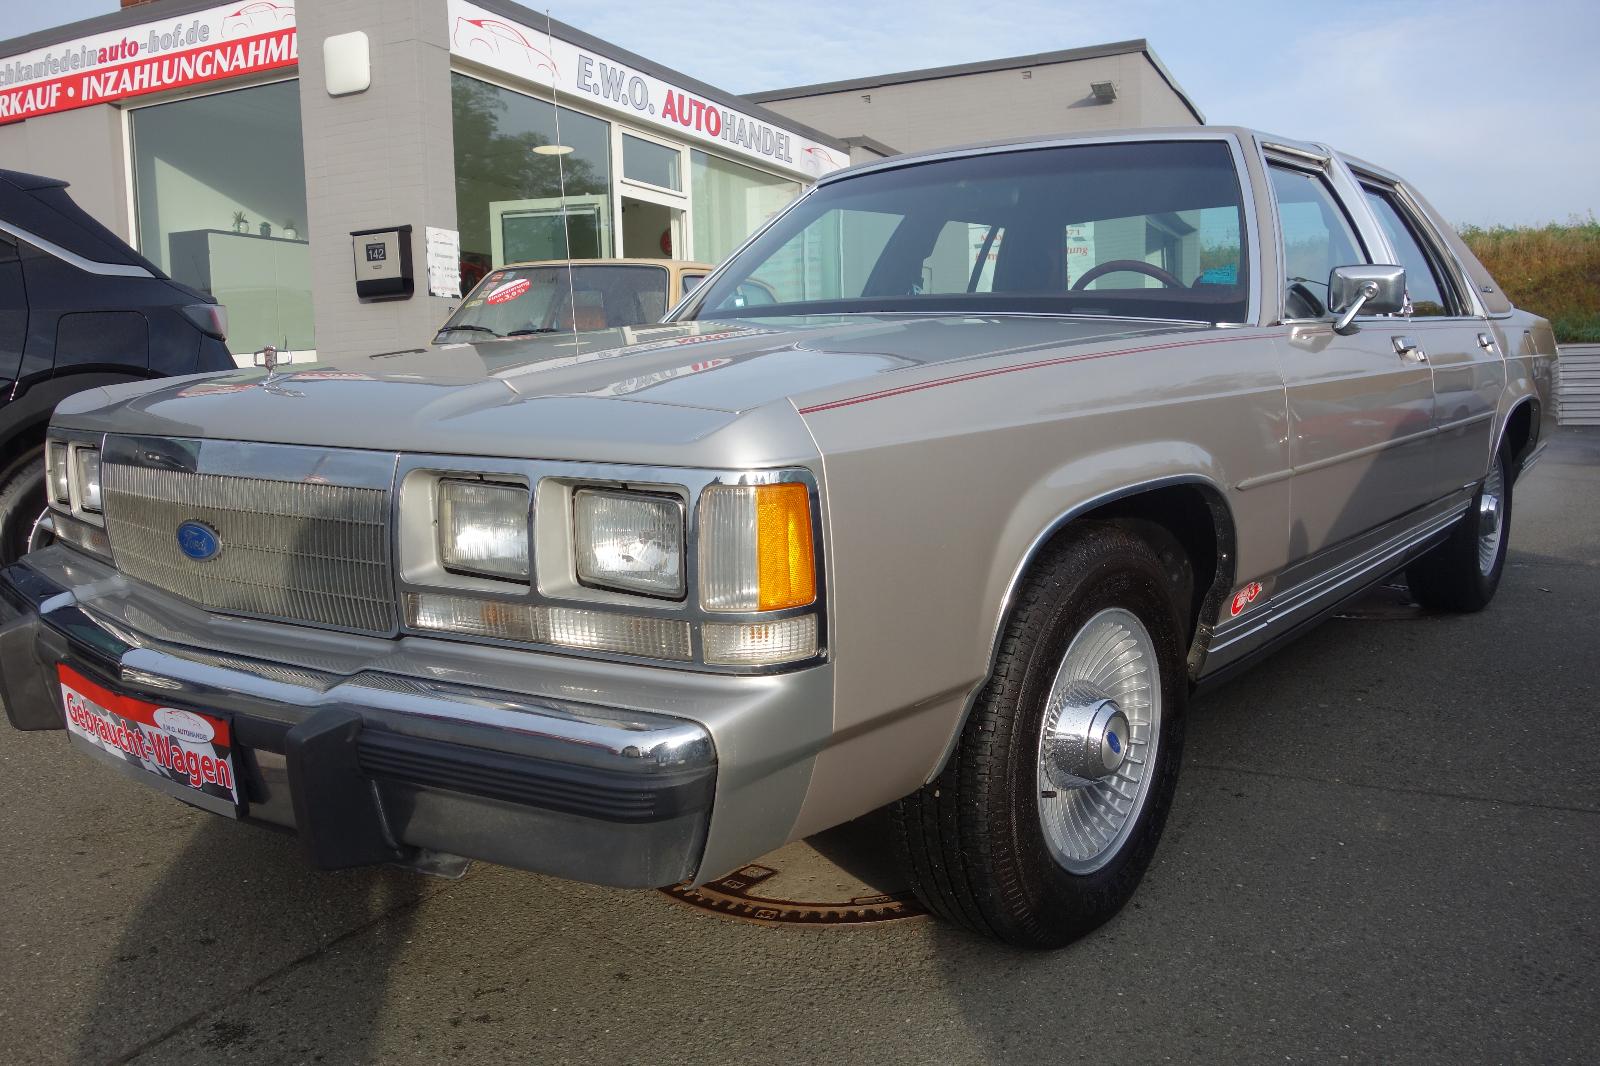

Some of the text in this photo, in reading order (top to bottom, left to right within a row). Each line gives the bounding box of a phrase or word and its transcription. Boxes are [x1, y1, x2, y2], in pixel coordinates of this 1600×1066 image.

[576, 54, 793, 164] E.W.O. AUTOHANDEL
[368, 248, 385, 260] 142
[184, 530, 209, 551] Ford
[66, 692, 233, 789] Gebraucht-Wagen
